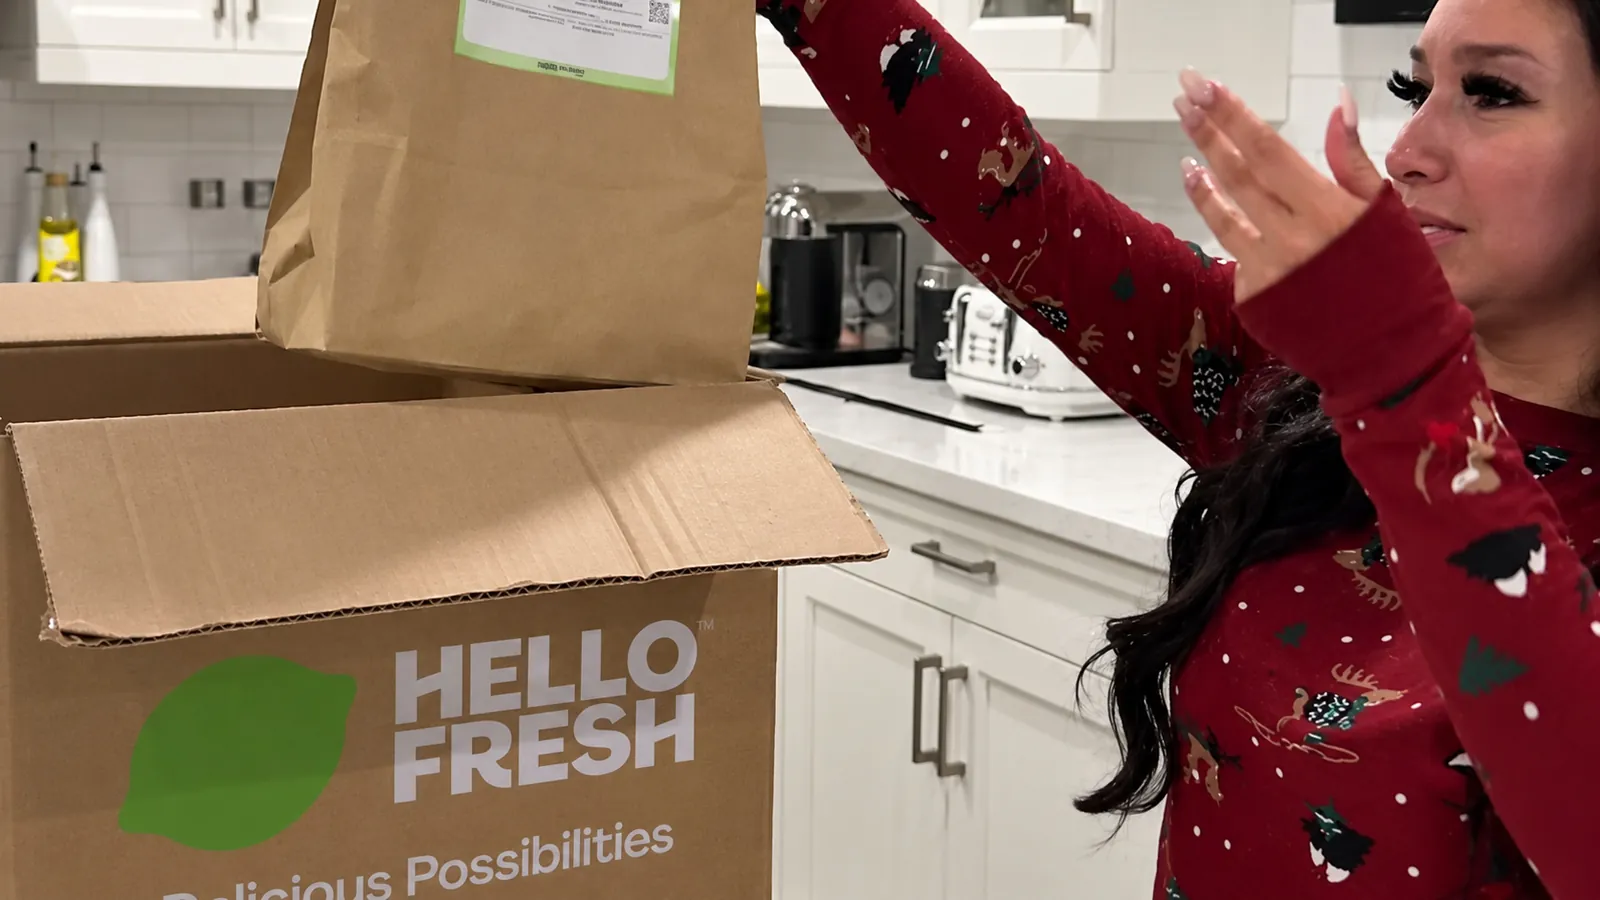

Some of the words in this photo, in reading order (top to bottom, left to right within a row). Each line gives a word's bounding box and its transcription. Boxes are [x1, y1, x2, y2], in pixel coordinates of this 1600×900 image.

[395, 620, 698, 725] HELLO
[394, 692, 695, 804] FRESH
[163, 871, 392, 900] iious
[408, 821, 674, 896] Possibilities
